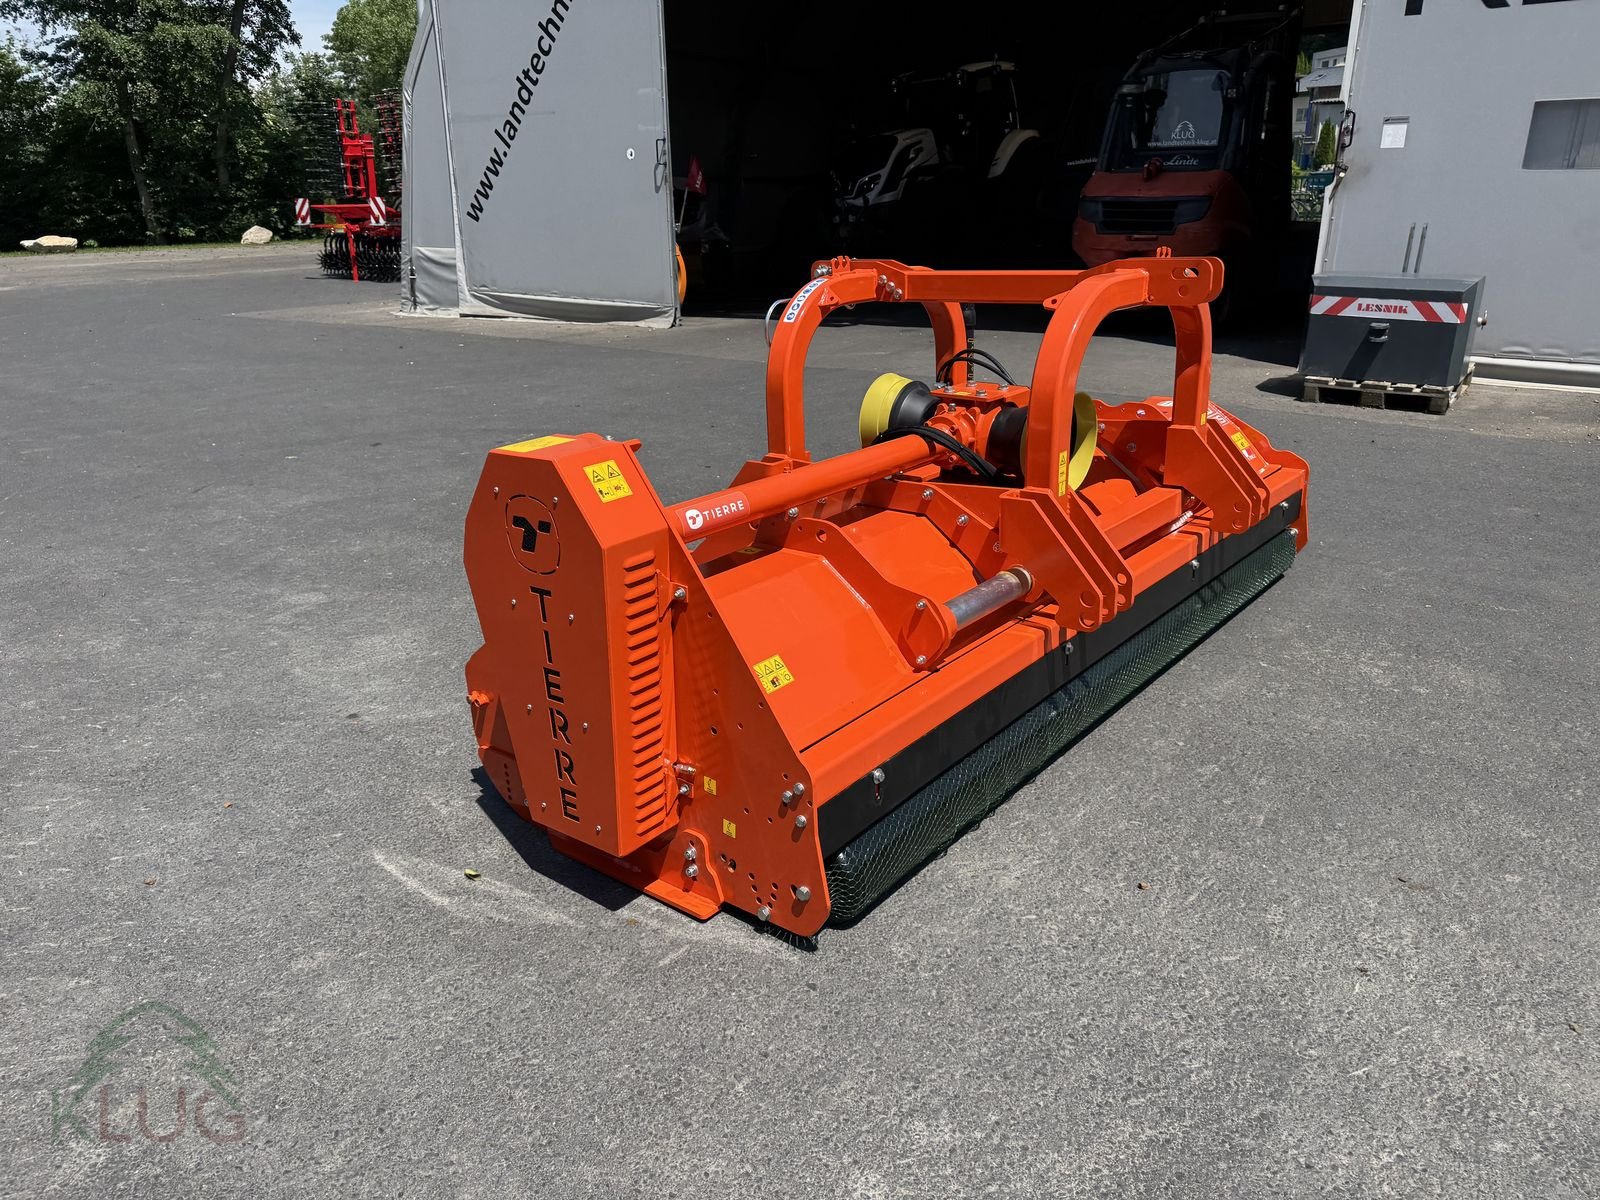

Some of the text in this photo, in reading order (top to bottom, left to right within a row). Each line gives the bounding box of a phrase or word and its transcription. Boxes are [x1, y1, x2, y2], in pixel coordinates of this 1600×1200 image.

[466, 0, 573, 223] www.landtechn
[1171, 131, 1195, 140] KLUG
[1163, 154, 1200, 166] Linde
[1357, 303, 1409, 314] LESNIK
[703, 500, 745, 521] TIERRE
[529, 585, 581, 824] TIERRE
